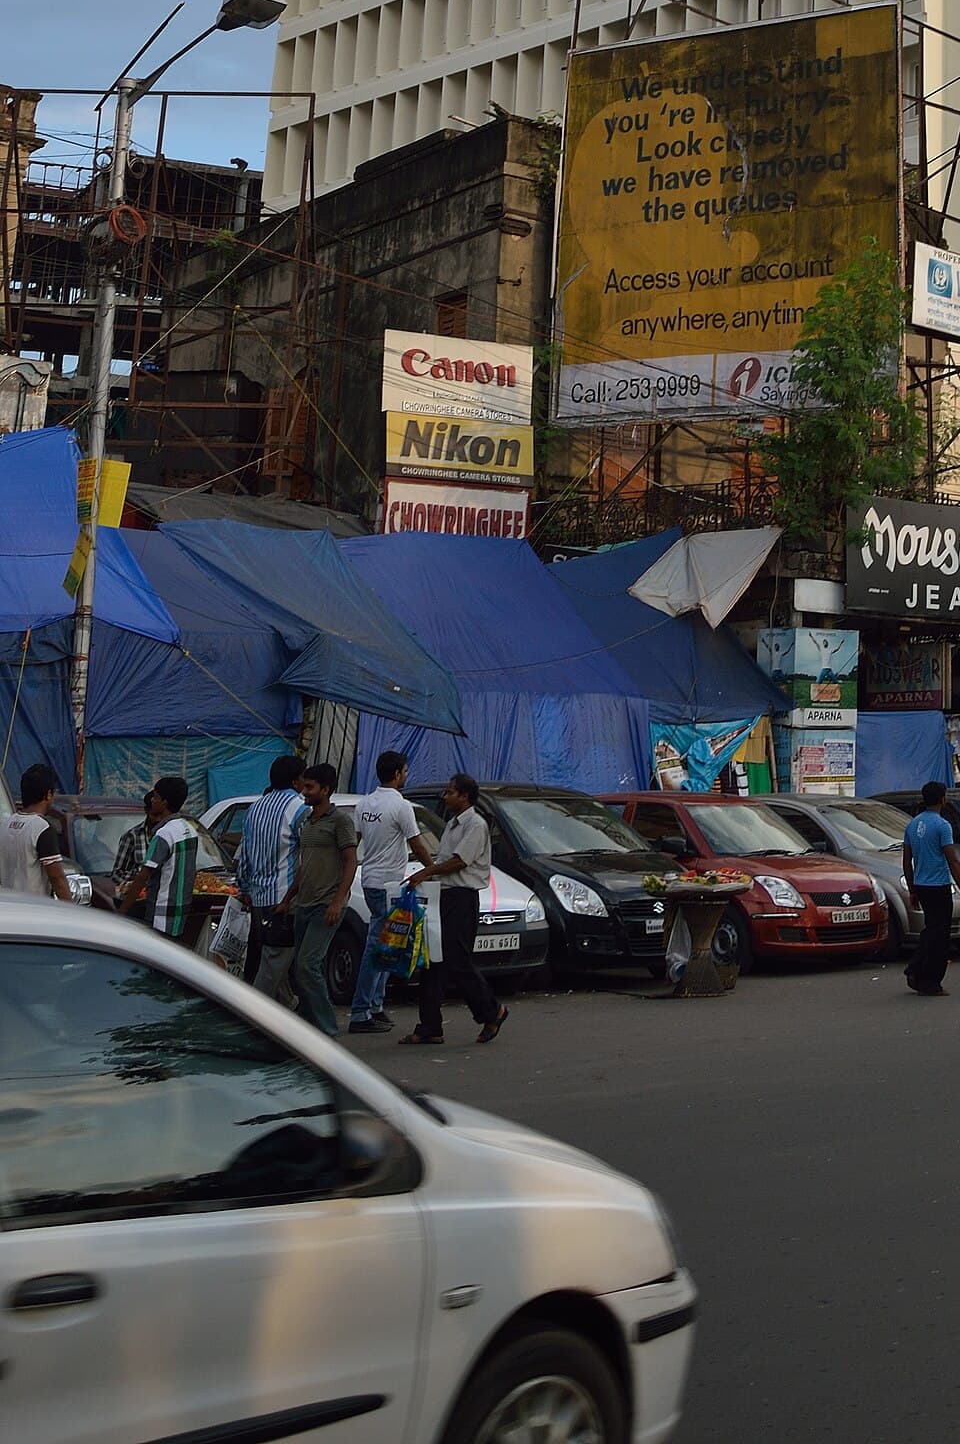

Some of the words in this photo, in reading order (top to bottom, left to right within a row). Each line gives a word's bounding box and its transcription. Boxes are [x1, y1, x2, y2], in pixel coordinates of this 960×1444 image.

[622, 75, 663, 103] We
[672, 47, 843, 96] understand
[604, 109, 650, 144] you
[637, 131, 703, 164] Look
[709, 118, 811, 153] closely
[602, 175, 637, 197] we
[648, 166, 712, 193] have
[719, 143, 848, 185] removed
[642, 196, 686, 224] the
[693, 189, 799, 226] queues
[603, 267, 681, 294] Access
[686, 265, 732, 292] your
[740, 253, 835, 284] account
[400, 348, 517, 388] Canon
[764, 365, 796, 384] ICI
[571, 380, 612, 404] Call:
[400, 419, 521, 467] Nikon
[401, 466, 459, 479] CHOWRINGHEE
[459, 471, 491, 482] CAMERA
[491, 474, 521, 485] STORES
[807, 710, 842, 722] APARNA
[873, 691, 934, 704] APARNA
